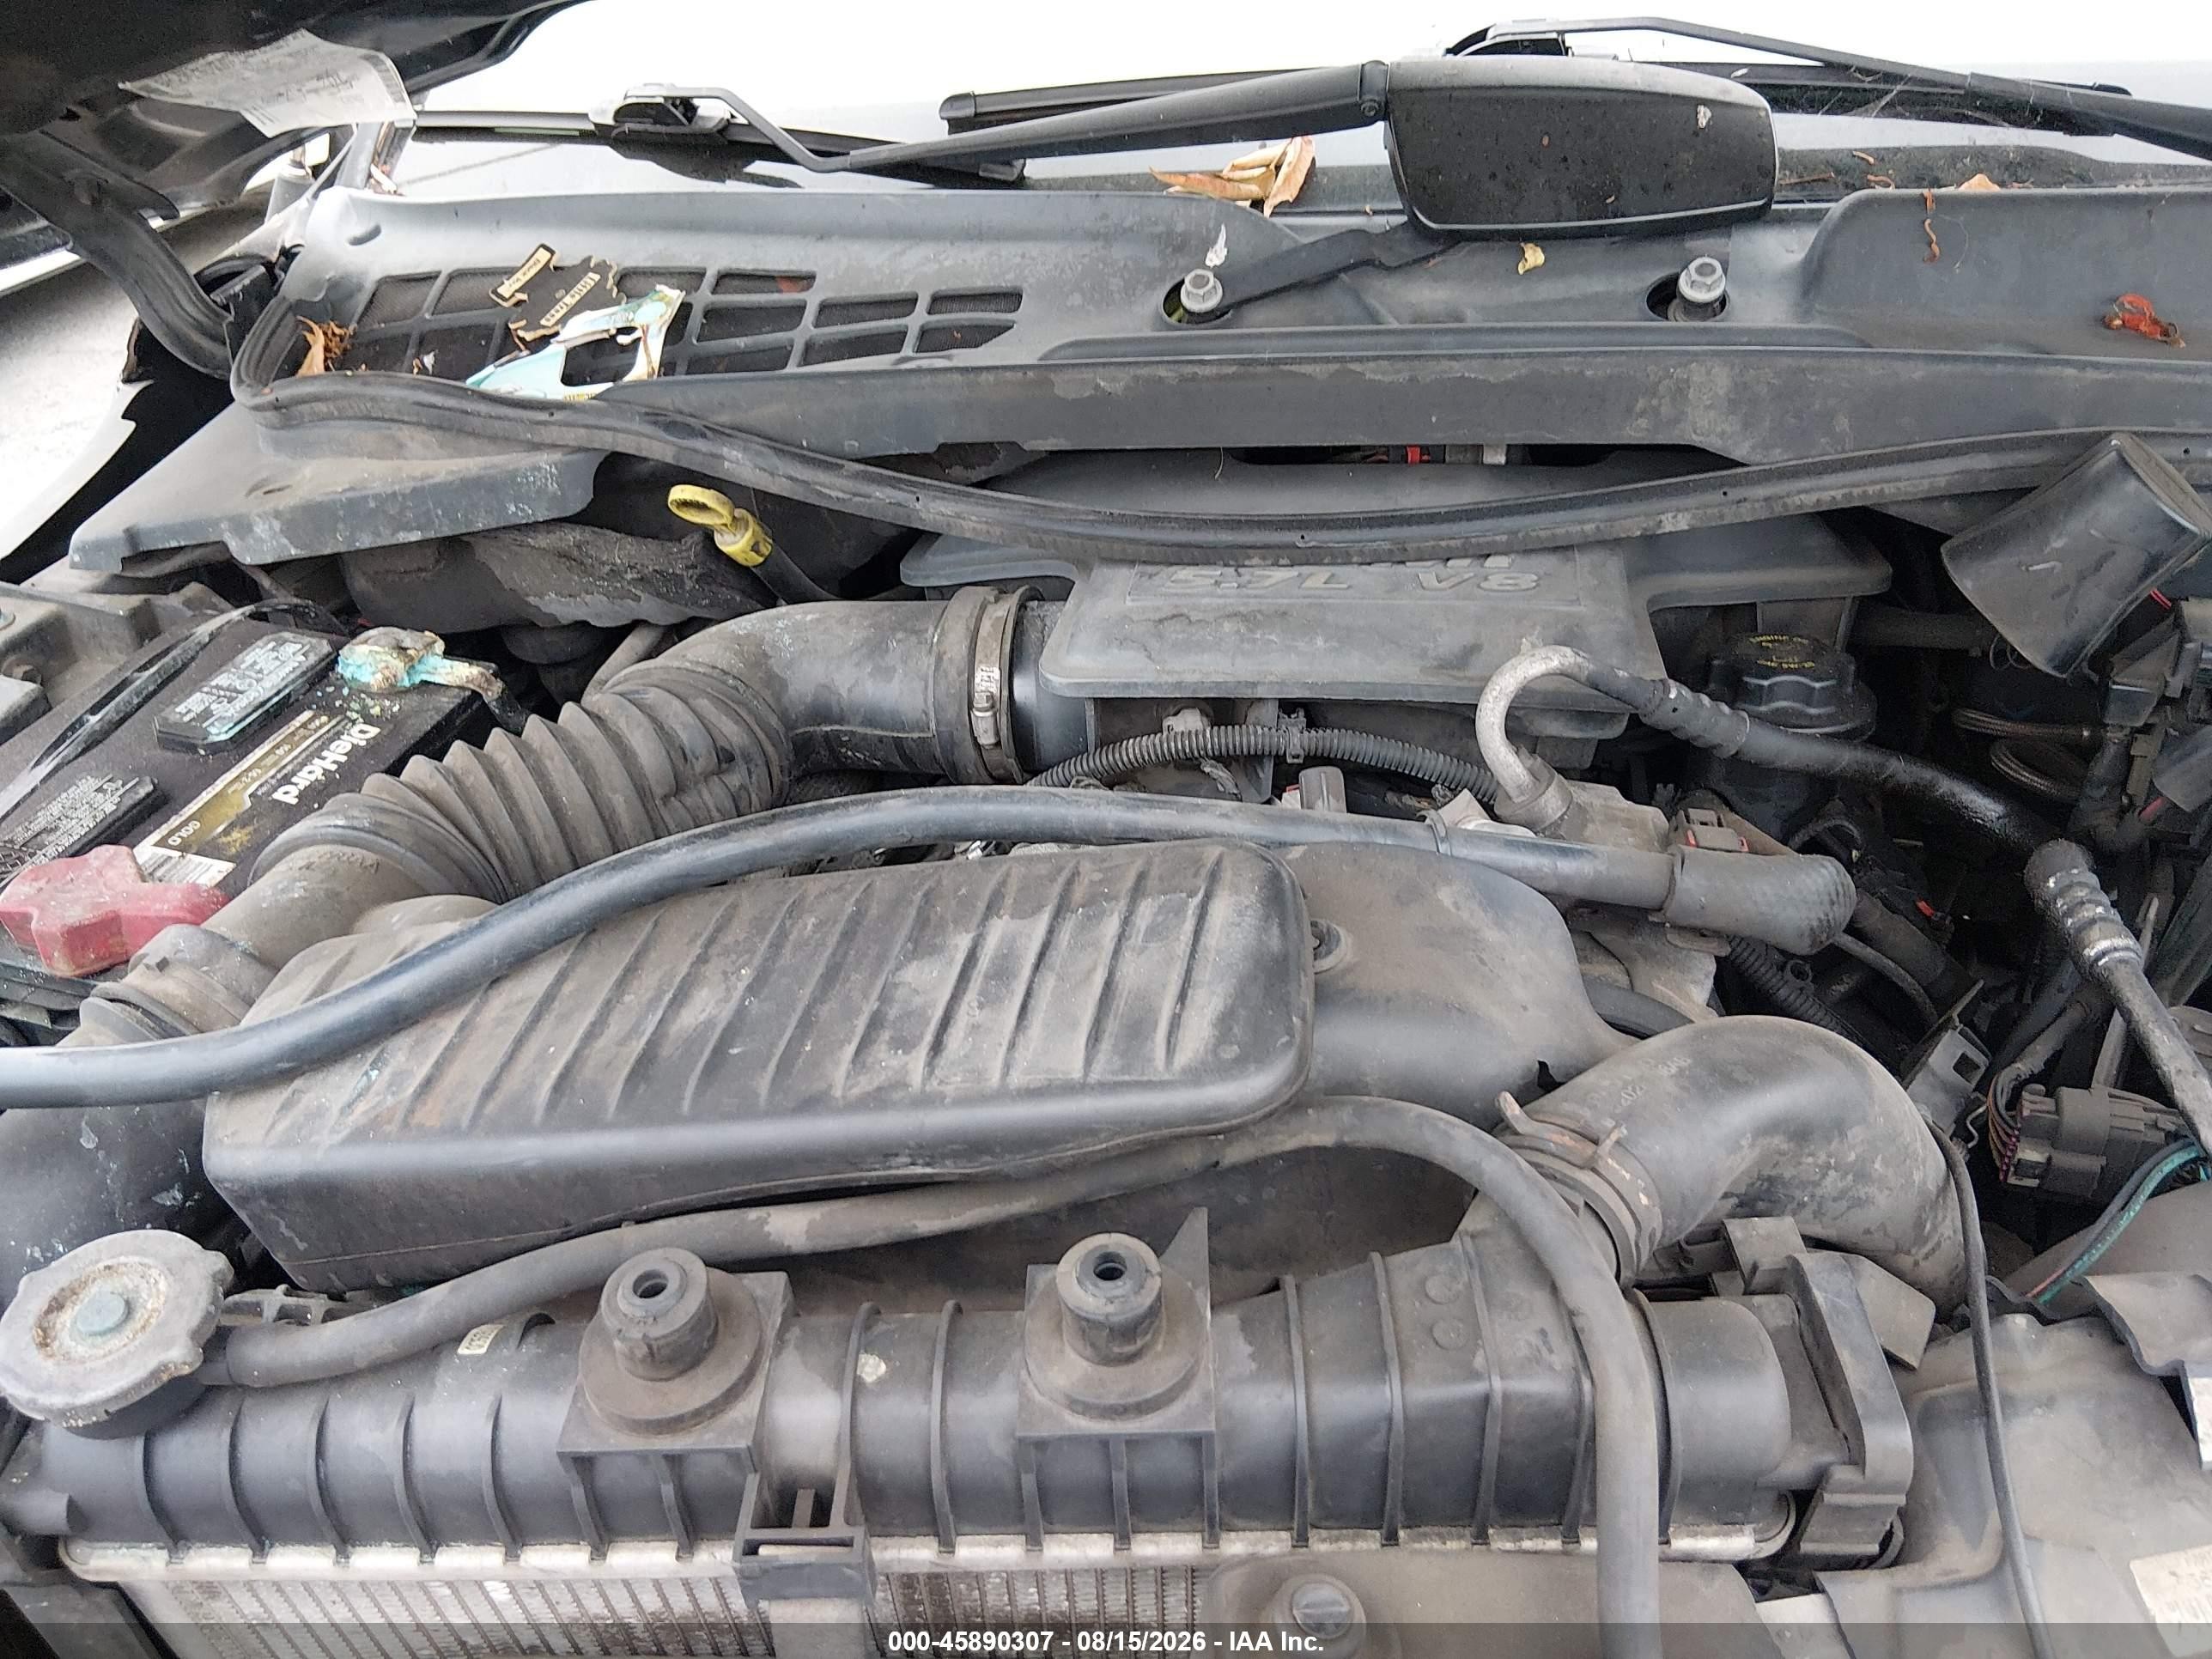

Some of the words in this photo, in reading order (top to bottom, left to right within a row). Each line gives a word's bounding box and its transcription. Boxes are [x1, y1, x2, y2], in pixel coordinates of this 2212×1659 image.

[1163, 568, 1350, 592] 5.7L
[1417, 571, 1542, 592] V8
[271, 723, 380, 805] DieHard
[167, 820, 201, 846] GOLD
